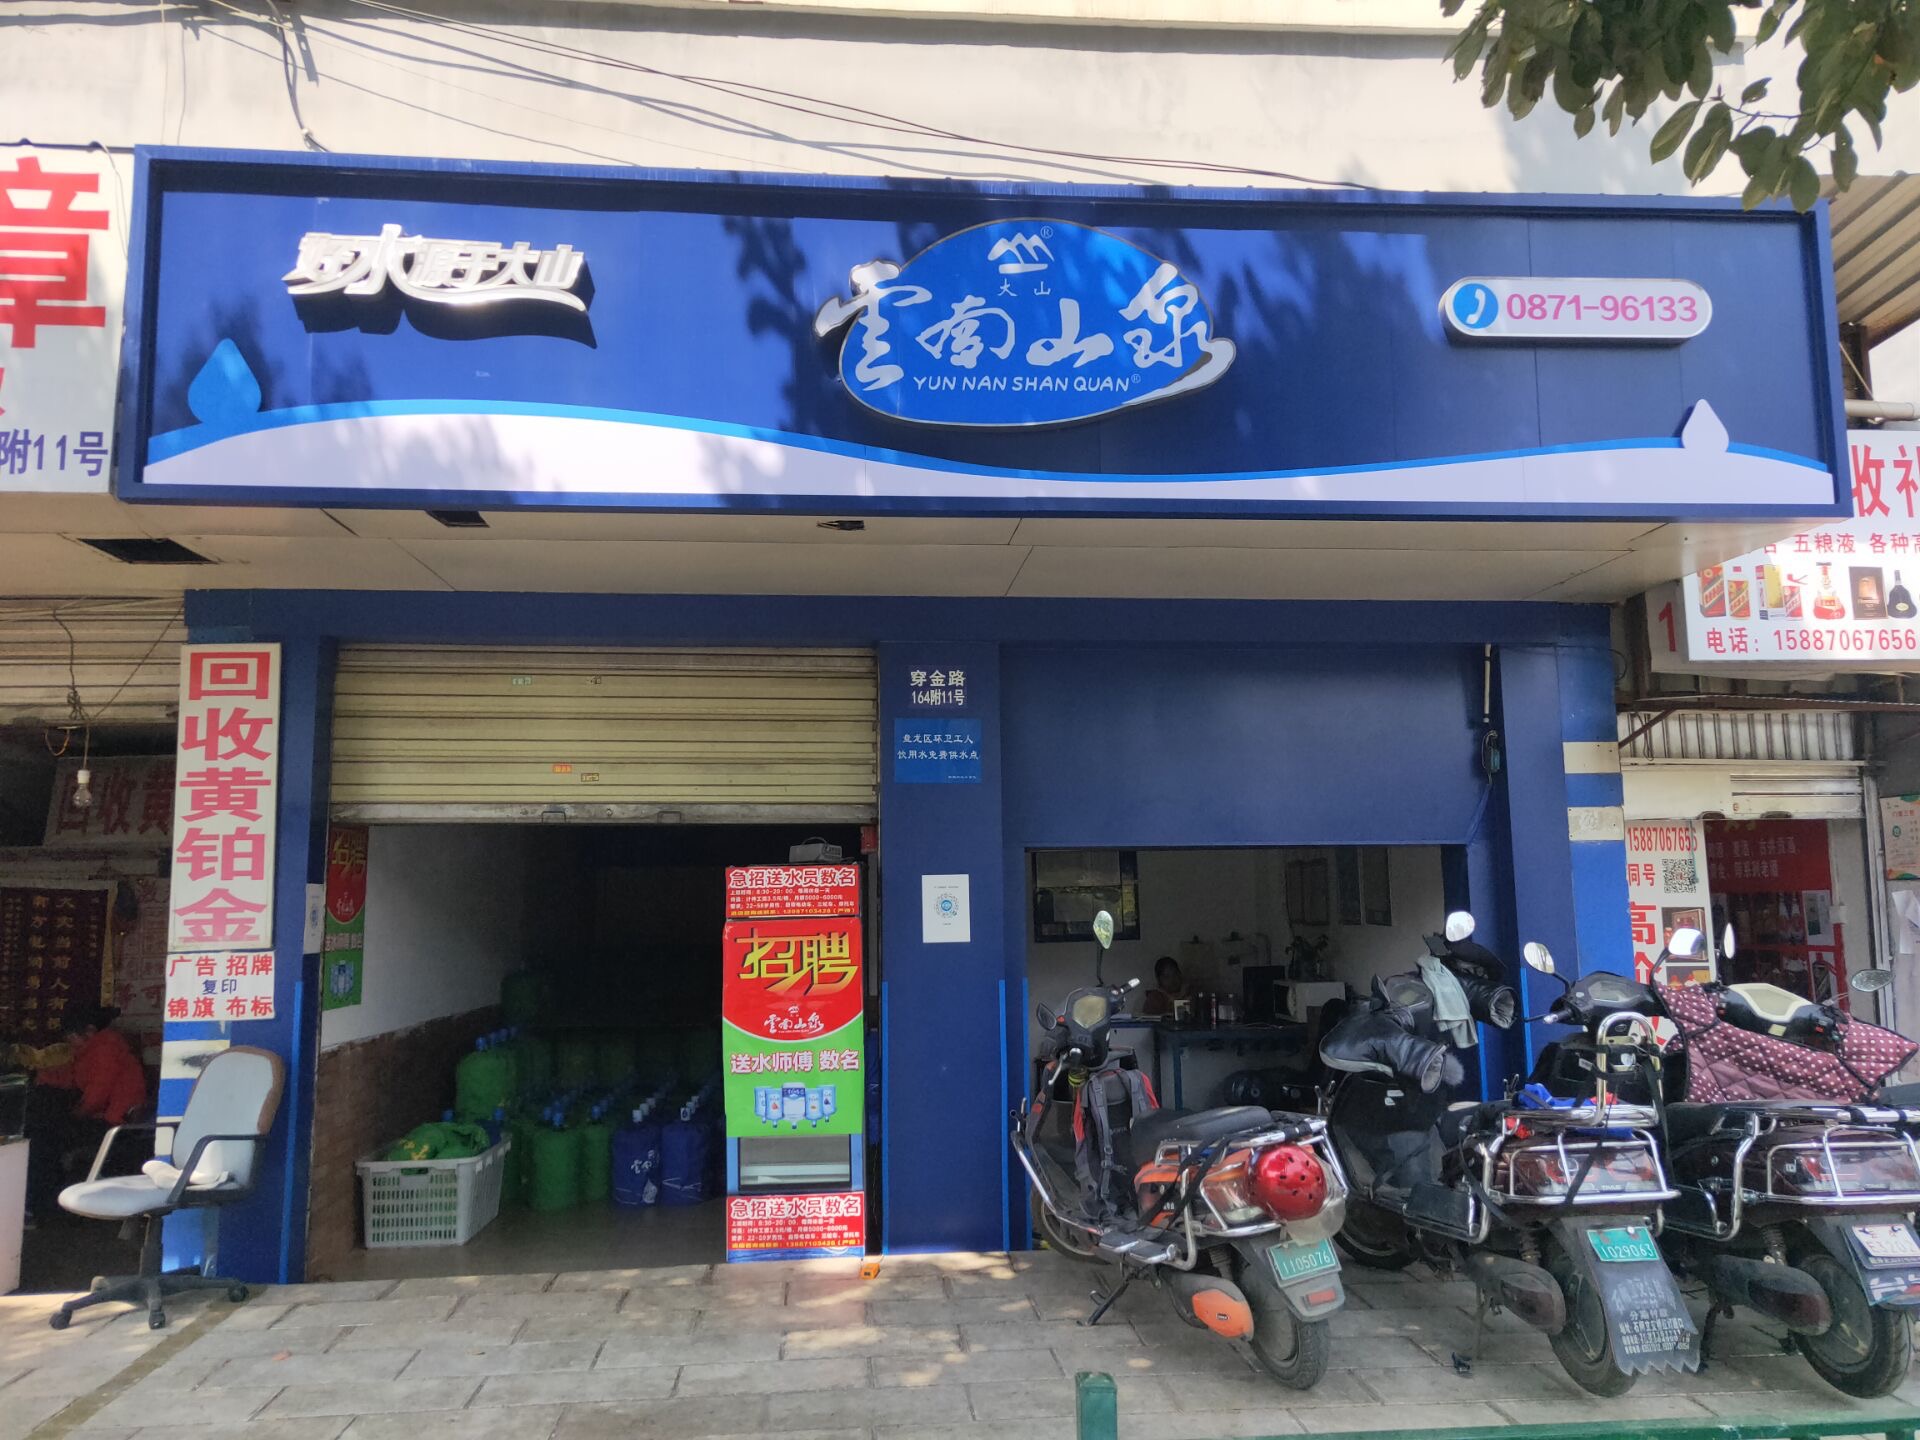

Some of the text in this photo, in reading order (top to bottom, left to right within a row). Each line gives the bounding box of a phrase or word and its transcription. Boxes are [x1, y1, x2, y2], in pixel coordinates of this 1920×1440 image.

[1506, 294, 1698, 322] 0871-96133
[913, 376, 1130, 391] YUN NAN SHAN QUAN
[1794, 533, 1856, 554] 五粮液
[1773, 629, 1916, 651] 15887067656
[910, 670, 966, 687] 穿金路
[912, 689, 965, 706] 164附11号
[175, 651, 273, 942] 回收黄铂金
[730, 868, 856, 888] 急招送水员数名
[169, 954, 273, 977] 广告 招牌
[735, 928, 858, 996] 招聘
[202, 978, 238, 995] 复印
[168, 995, 273, 1019] 锦旗 布标
[730, 1050, 860, 1074] 送水师傅 数名
[731, 1196, 861, 1219] 急招送水员数名
[1601, 1244, 1653, 1258] 1029063
